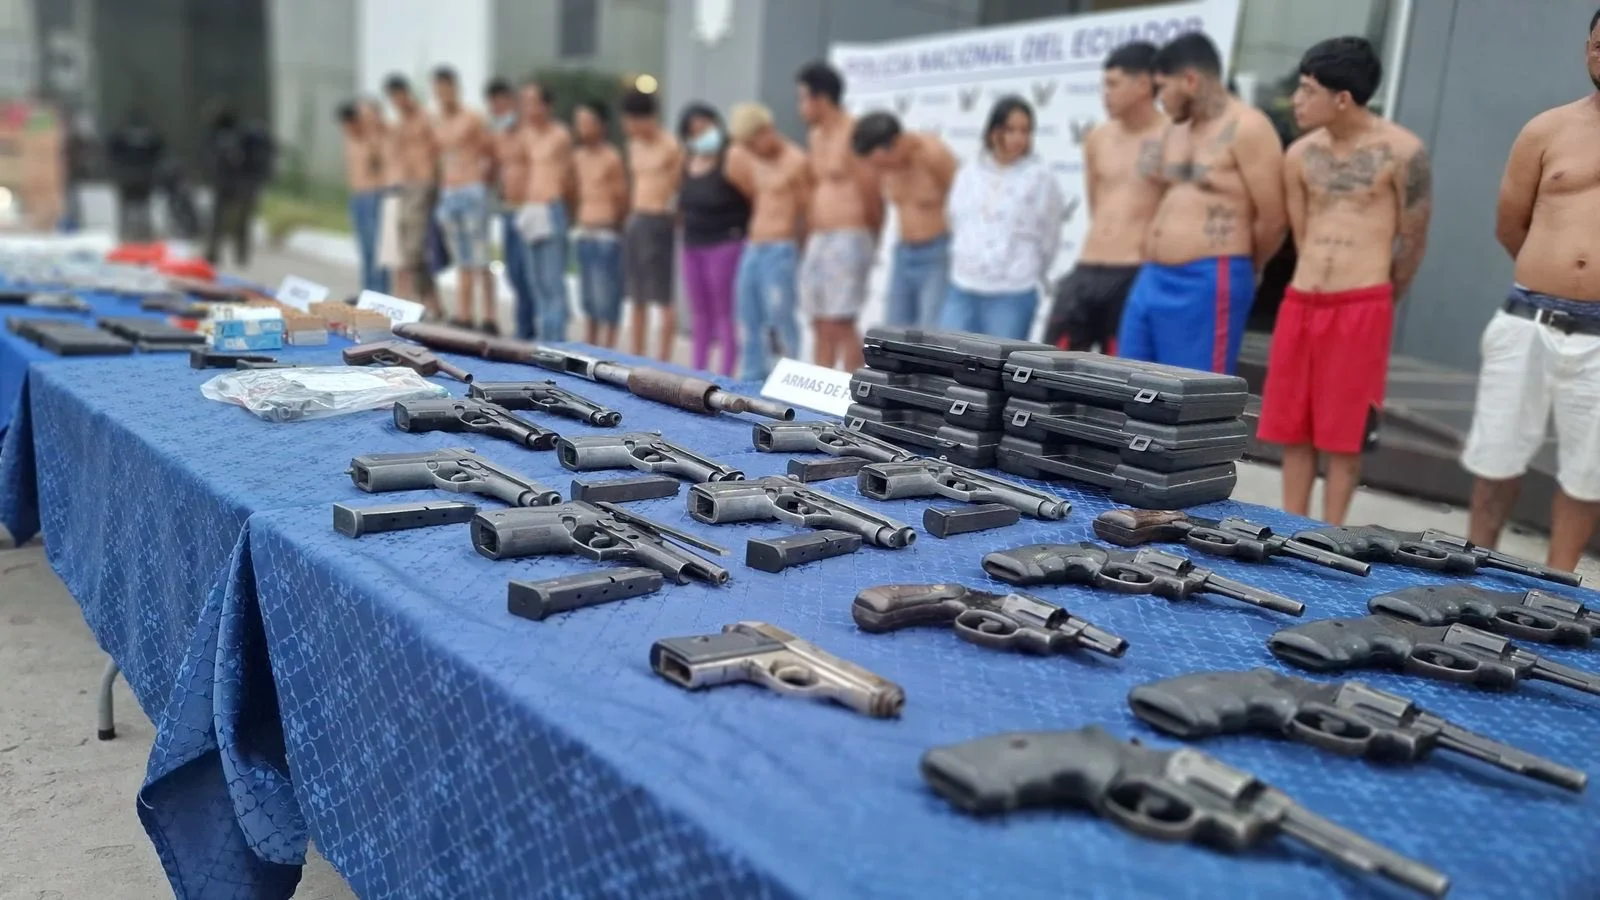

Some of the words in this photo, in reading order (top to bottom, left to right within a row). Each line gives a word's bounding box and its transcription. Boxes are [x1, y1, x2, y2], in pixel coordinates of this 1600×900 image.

[917, 39, 1015, 72] NACIONAL
[1020, 31, 1064, 63] DEL
[782, 374, 823, 392] ARMAS
[824, 383, 841, 397] DE
